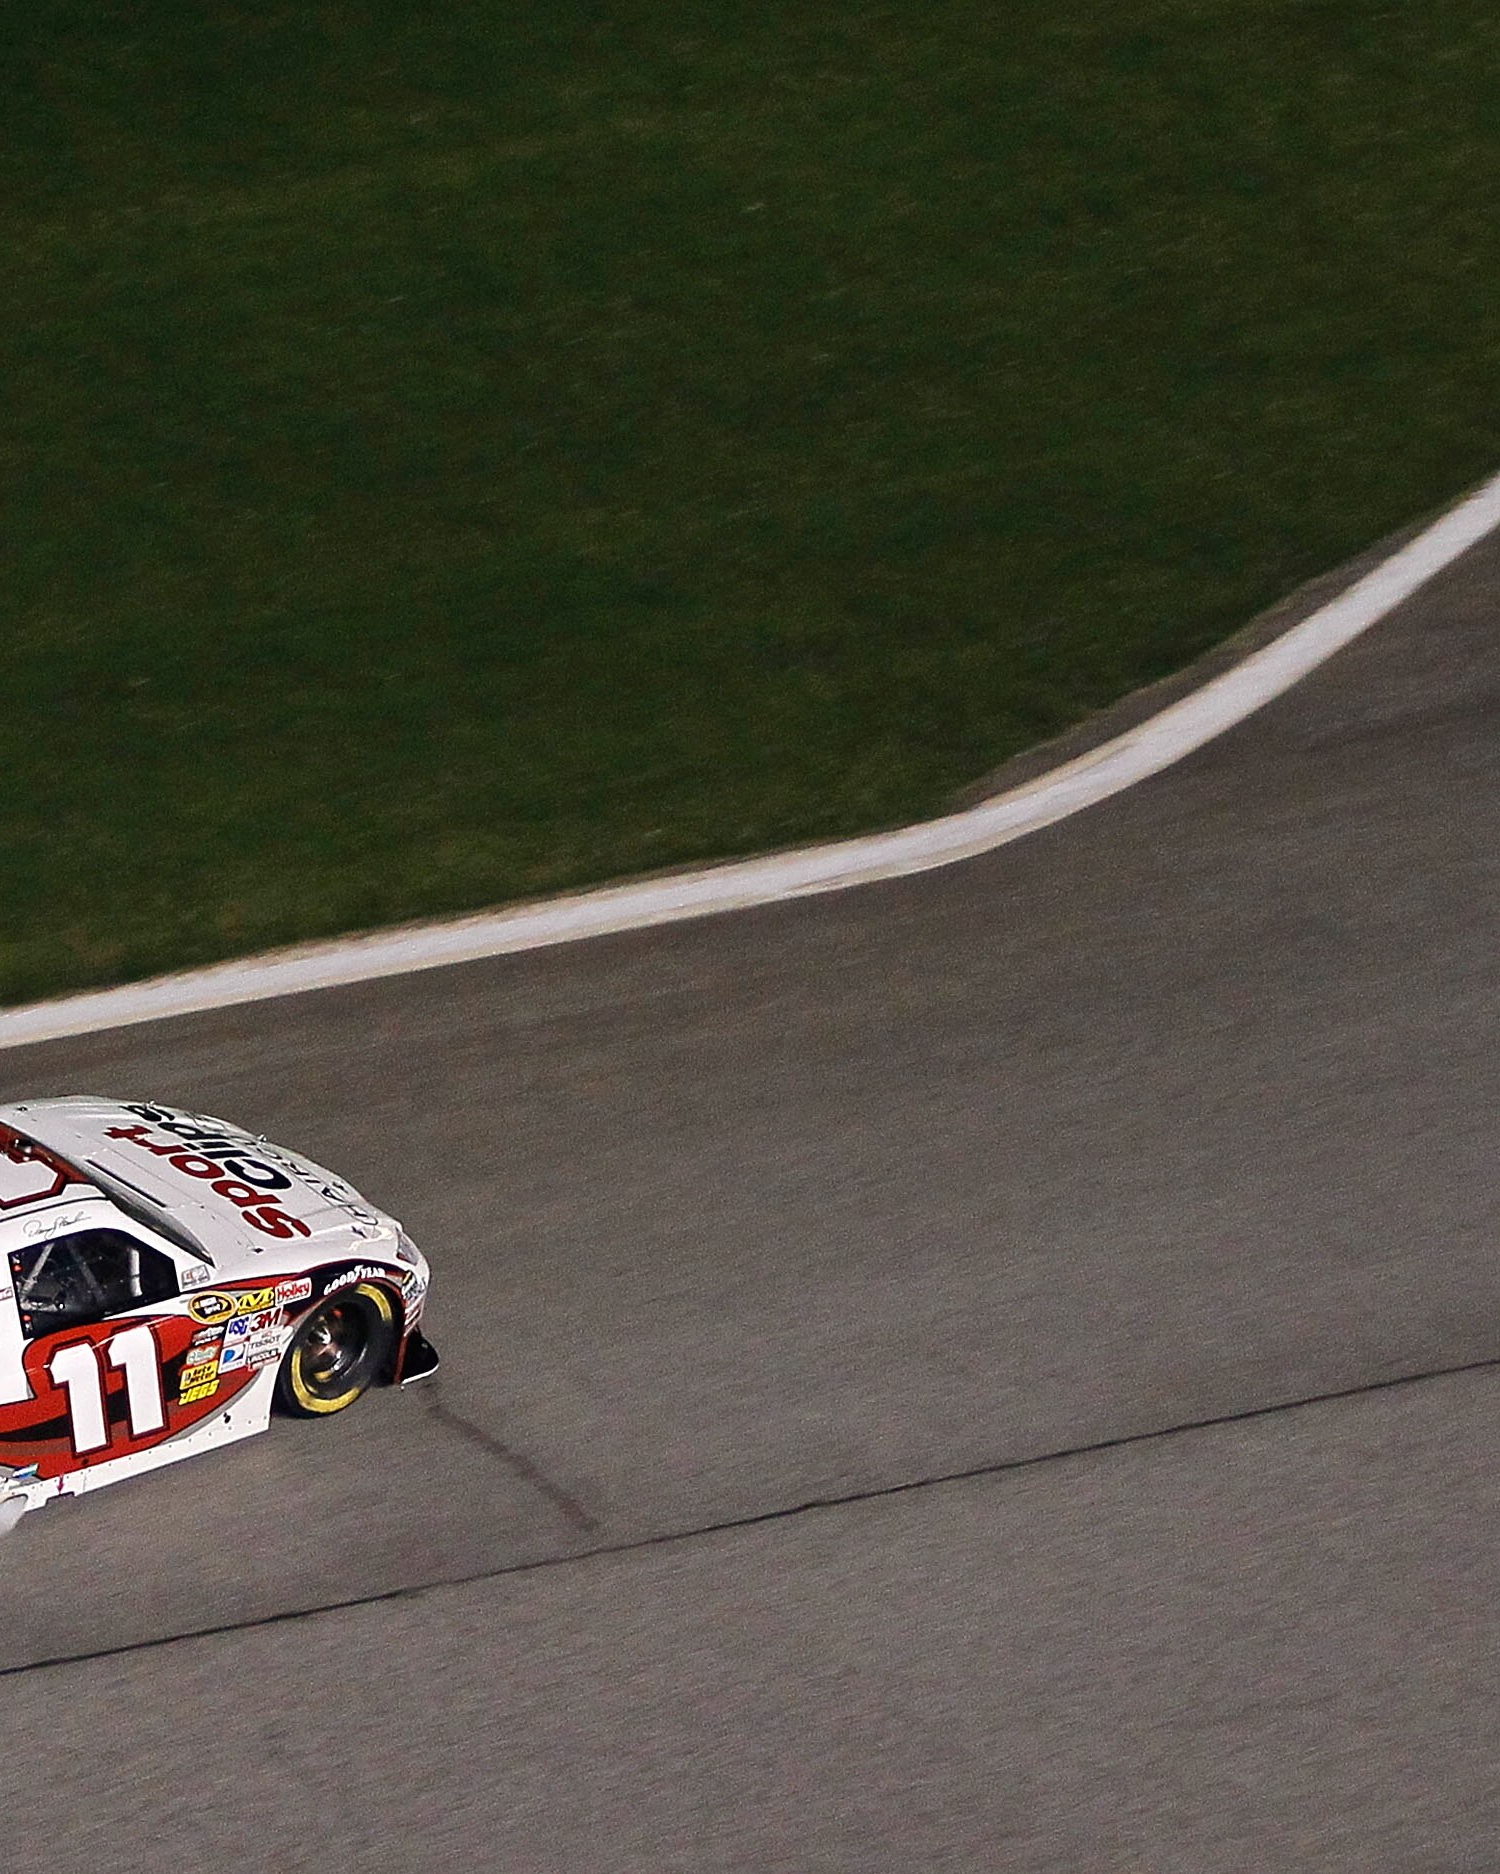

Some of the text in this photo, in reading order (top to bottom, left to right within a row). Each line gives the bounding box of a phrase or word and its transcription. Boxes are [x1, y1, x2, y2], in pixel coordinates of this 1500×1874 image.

[105, 1124, 312, 1239] Sport
[119, 1104, 292, 1190] Clips
[250, 1309, 279, 1332] 3M
[49, 1325, 165, 1453] 11
[179, 1380, 219, 1405] JEGS
